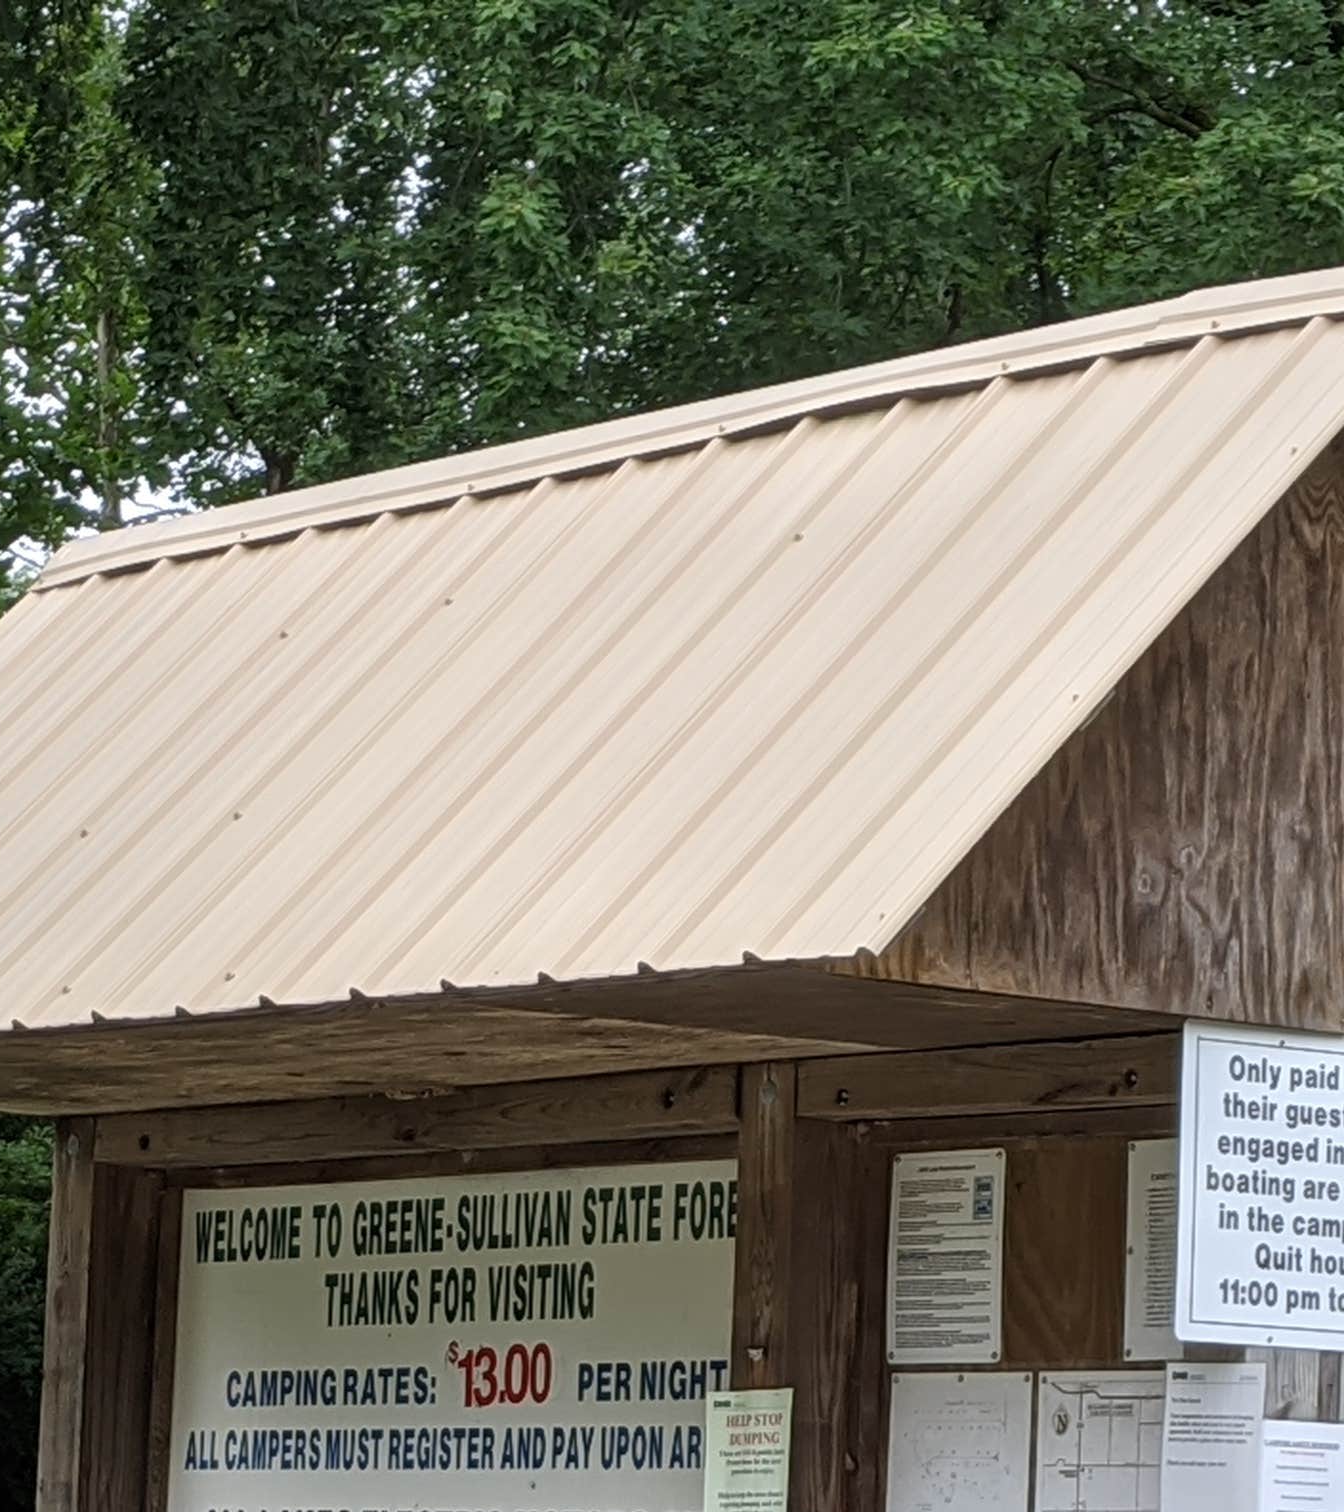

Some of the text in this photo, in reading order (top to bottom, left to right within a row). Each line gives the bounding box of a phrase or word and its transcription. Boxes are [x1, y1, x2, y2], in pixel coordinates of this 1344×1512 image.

[1229, 1055, 1281, 1090] Only
[1289, 1063, 1340, 1092] paid
[1223, 1092, 1278, 1121] their
[1217, 1135, 1319, 1164] engaged
[1206, 1165, 1296, 1201] boating
[1303, 1179, 1340, 1201] are
[196, 1206, 302, 1263] WELCOME
[313, 1203, 342, 1258] TO
[353, 1190, 572, 1256] GREENE-SULLIVAN
[582, 1185, 663, 1245] STATE
[1218, 1203, 1240, 1230] in
[1247, 1207, 1285, 1233] the
[1255, 1243, 1303, 1271] Quit
[325, 1261, 594, 1327] THANKS FOR VISITING
[1219, 1279, 1278, 1307] 11:00
[1285, 1288, 1321, 1314] pm
[227, 1369, 336, 1407] CAMPING
[344, 1366, 436, 1405] RATES:
[578, 1362, 632, 1402] PER
[639, 1360, 728, 1401] NIGHT
[726, 1412, 783, 1428] HELP STOP
[185, 1431, 218, 1471] ALL
[225, 1429, 321, 1471] CAMPERS
[325, 1428, 384, 1470] MUST
[388, 1427, 494, 1470] REGISTER
[500, 1427, 546, 1469] AND
[552, 1427, 594, 1469] PAY
[601, 1426, 664, 1469] UPON
[729, 1432, 781, 1446] DUMPING
